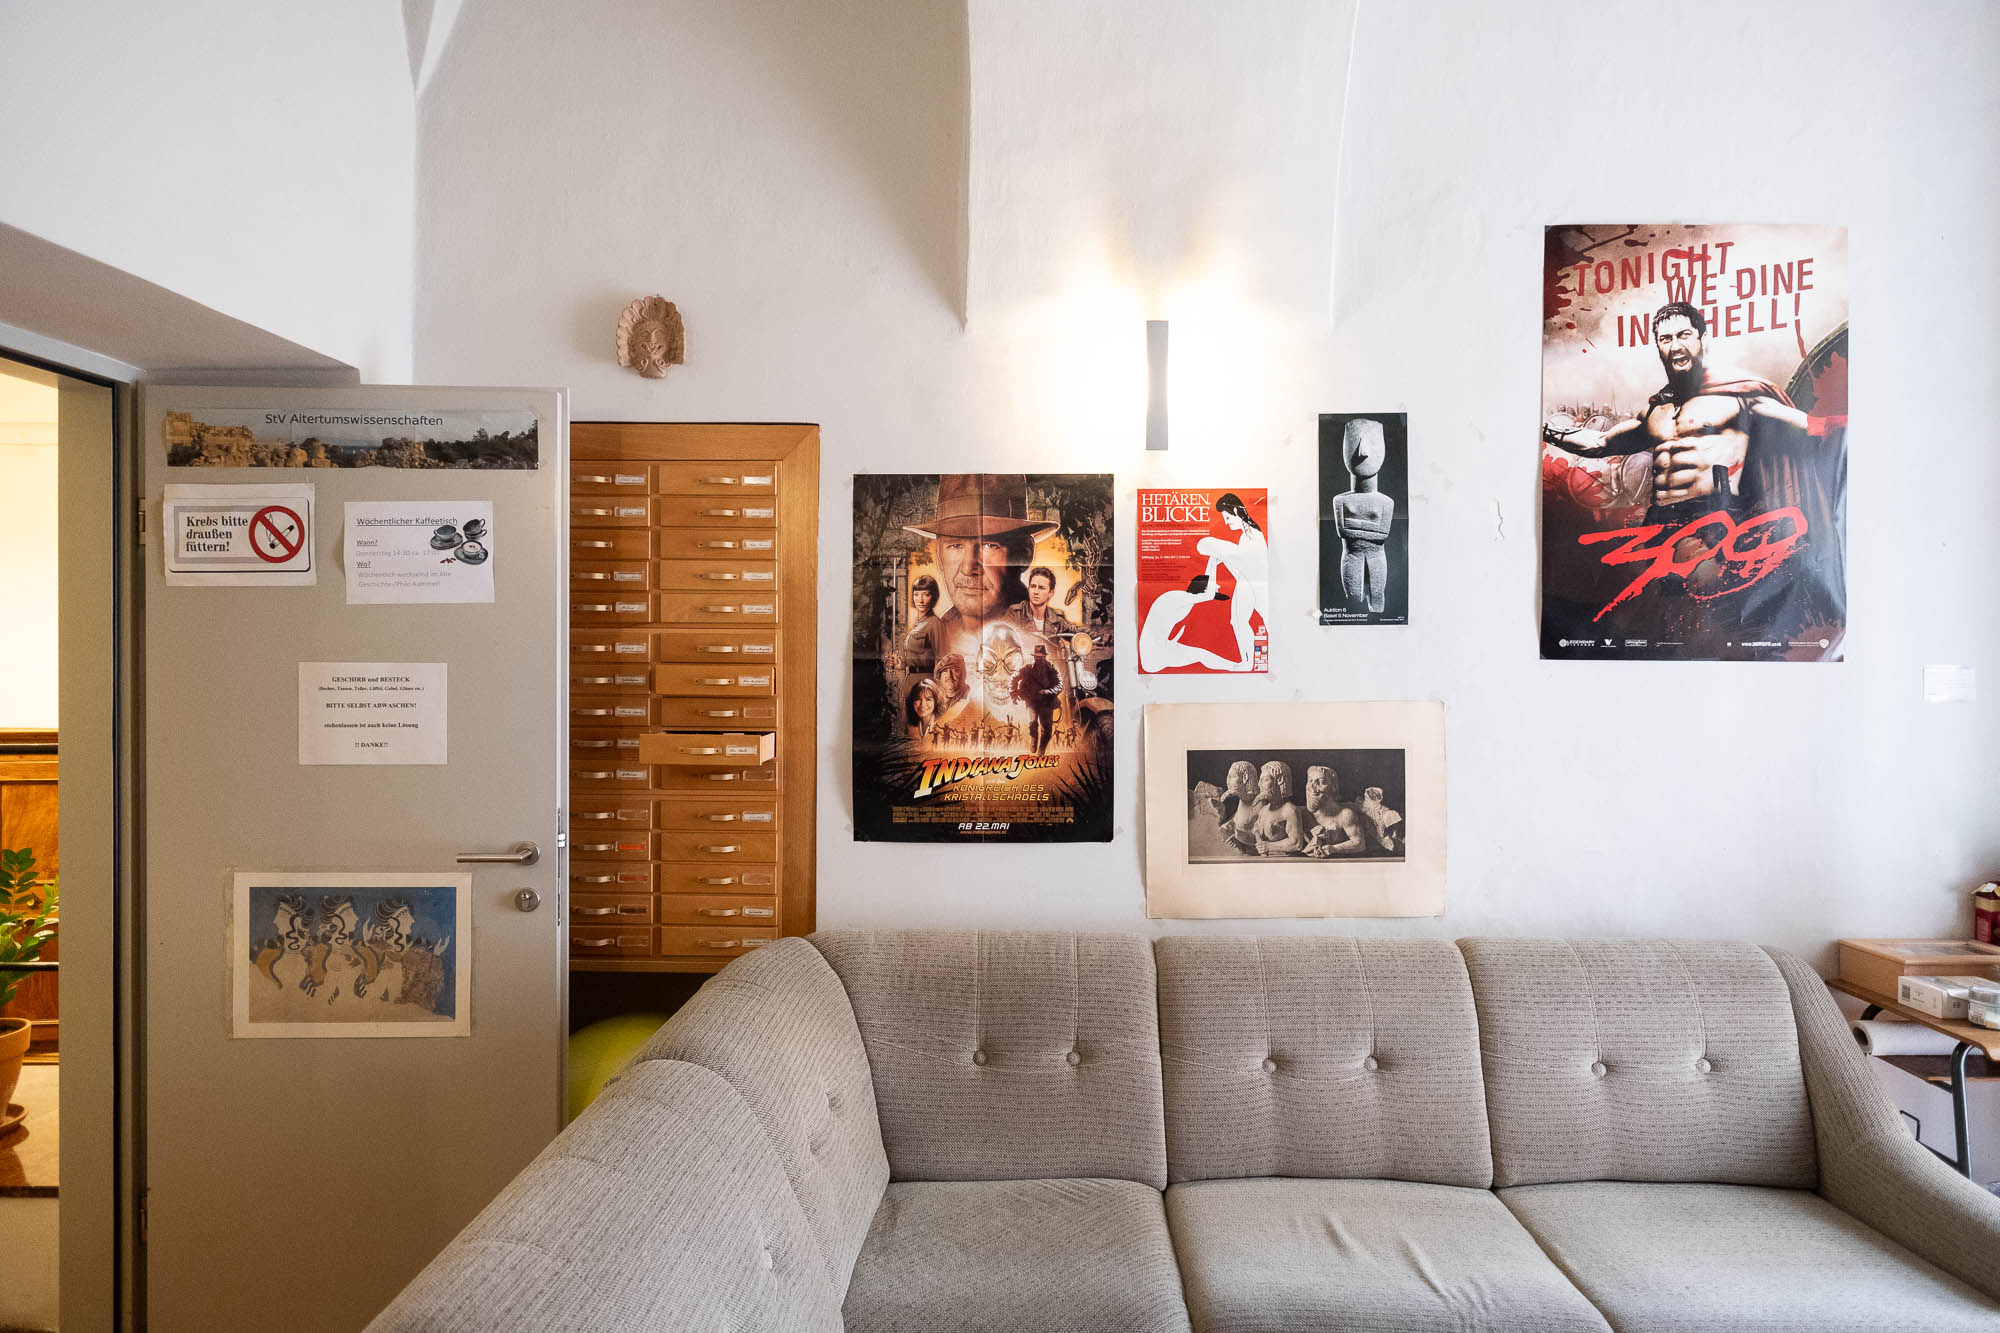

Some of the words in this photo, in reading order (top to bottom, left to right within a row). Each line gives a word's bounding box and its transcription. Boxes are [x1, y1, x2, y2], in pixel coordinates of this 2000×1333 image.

[1573, 242, 1734, 296] TONIGHT
[1667, 273, 1717, 306] WE
[1736, 258, 1814, 299] DINE
[1617, 313, 1650, 347] IN
[265, 413, 286, 424] StV
[289, 414, 443, 426] Altertumswissenschaften
[1141, 491, 1211, 506] HETÄREN
[186, 516, 218, 527] Krebs
[221, 515, 248, 527] bitte
[415, 517, 458, 526] Kaffeetisch
[1141, 506, 1210, 522] BLICKE
[186, 528, 232, 539] draußen
[186, 541, 230, 552] füttern!
[1578, 506, 1810, 622] 300
[913, 756, 1012, 799] INDIANA
[1006, 754, 1061, 780] JONES
[958, 822, 973, 830] AB
